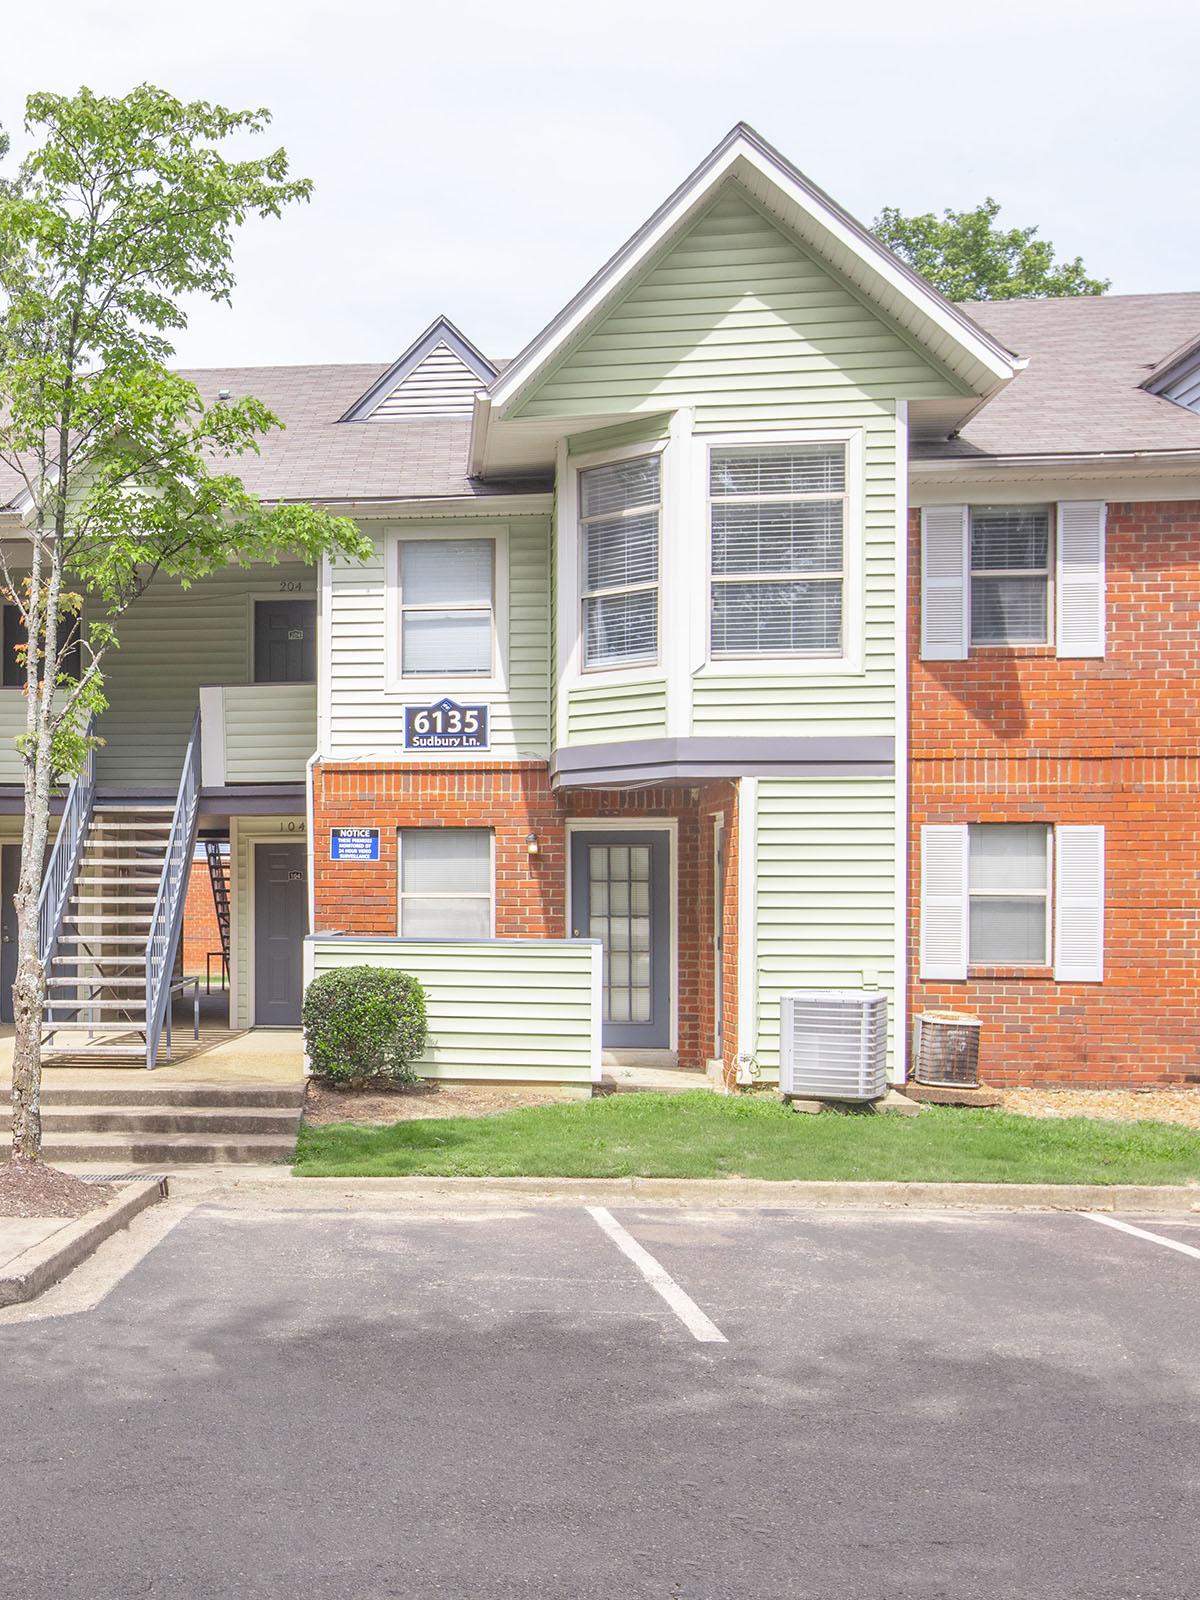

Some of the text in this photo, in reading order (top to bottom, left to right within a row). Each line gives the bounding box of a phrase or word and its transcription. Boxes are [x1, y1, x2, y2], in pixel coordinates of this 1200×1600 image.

[279, 581, 303, 592] 204
[414, 710, 479, 734] 6135
[412, 735, 480, 747] Sudbury Ln.
[280, 821, 305, 832] 104
